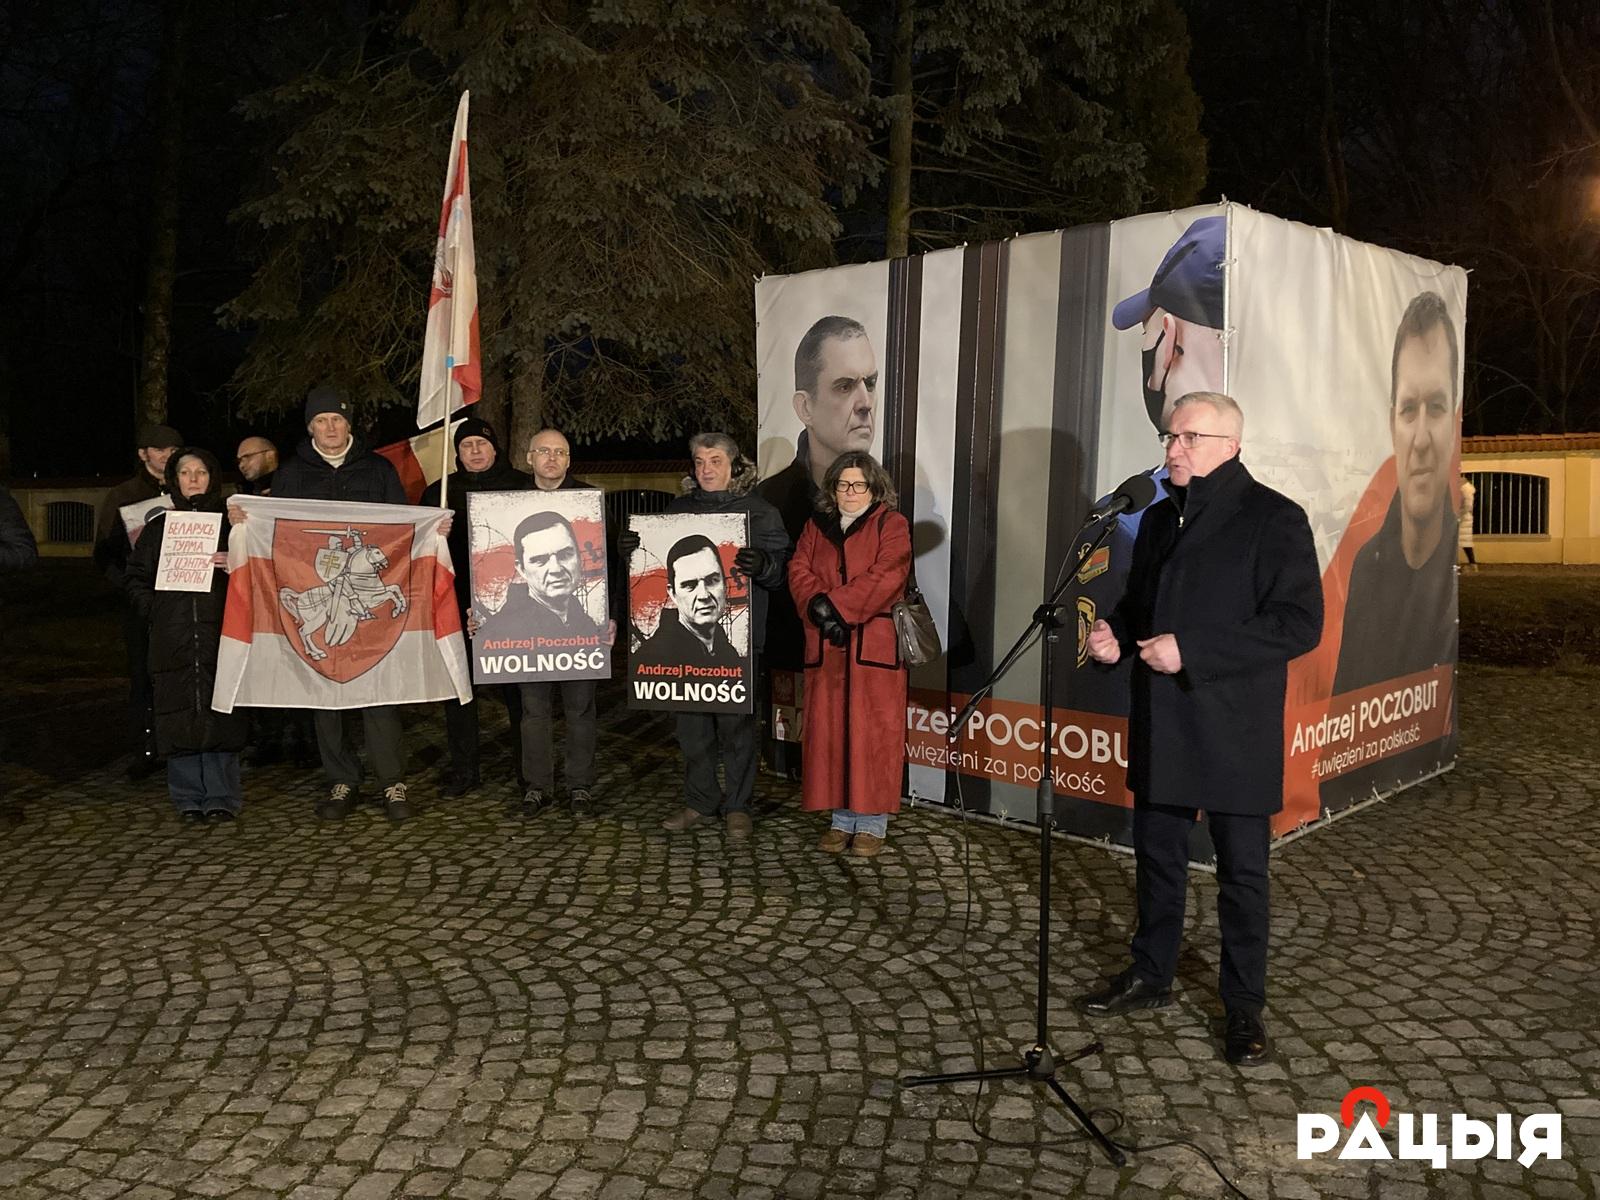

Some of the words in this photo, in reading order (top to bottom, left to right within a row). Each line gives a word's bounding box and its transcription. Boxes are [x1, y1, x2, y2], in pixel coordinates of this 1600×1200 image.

[168, 521, 215, 536] БЕЛАРУСЬ
[172, 540, 204, 553] ТУРМА
[483, 636, 535, 650] Andrzej
[537, 635, 599, 648] Poczobut
[480, 647, 605, 674] WOLNOŚĆ
[637, 664, 682, 678] Andrzej
[685, 665, 742, 678] Poczobut
[634, 680, 746, 703] WOLNOŚĆ
[1290, 705, 1355, 756] Andrzej
[1359, 680, 1438, 732] POCZOBUT
[907, 706, 956, 743] rzej
[968, 709, 1128, 768] POCZOBU
[905, 741, 978, 770] więzieni
[984, 757, 1007, 776] za
[1311, 741, 1365, 779] #uwięzieni
[1365, 741, 1378, 756] za
[1380, 723, 1420, 757] polskość
